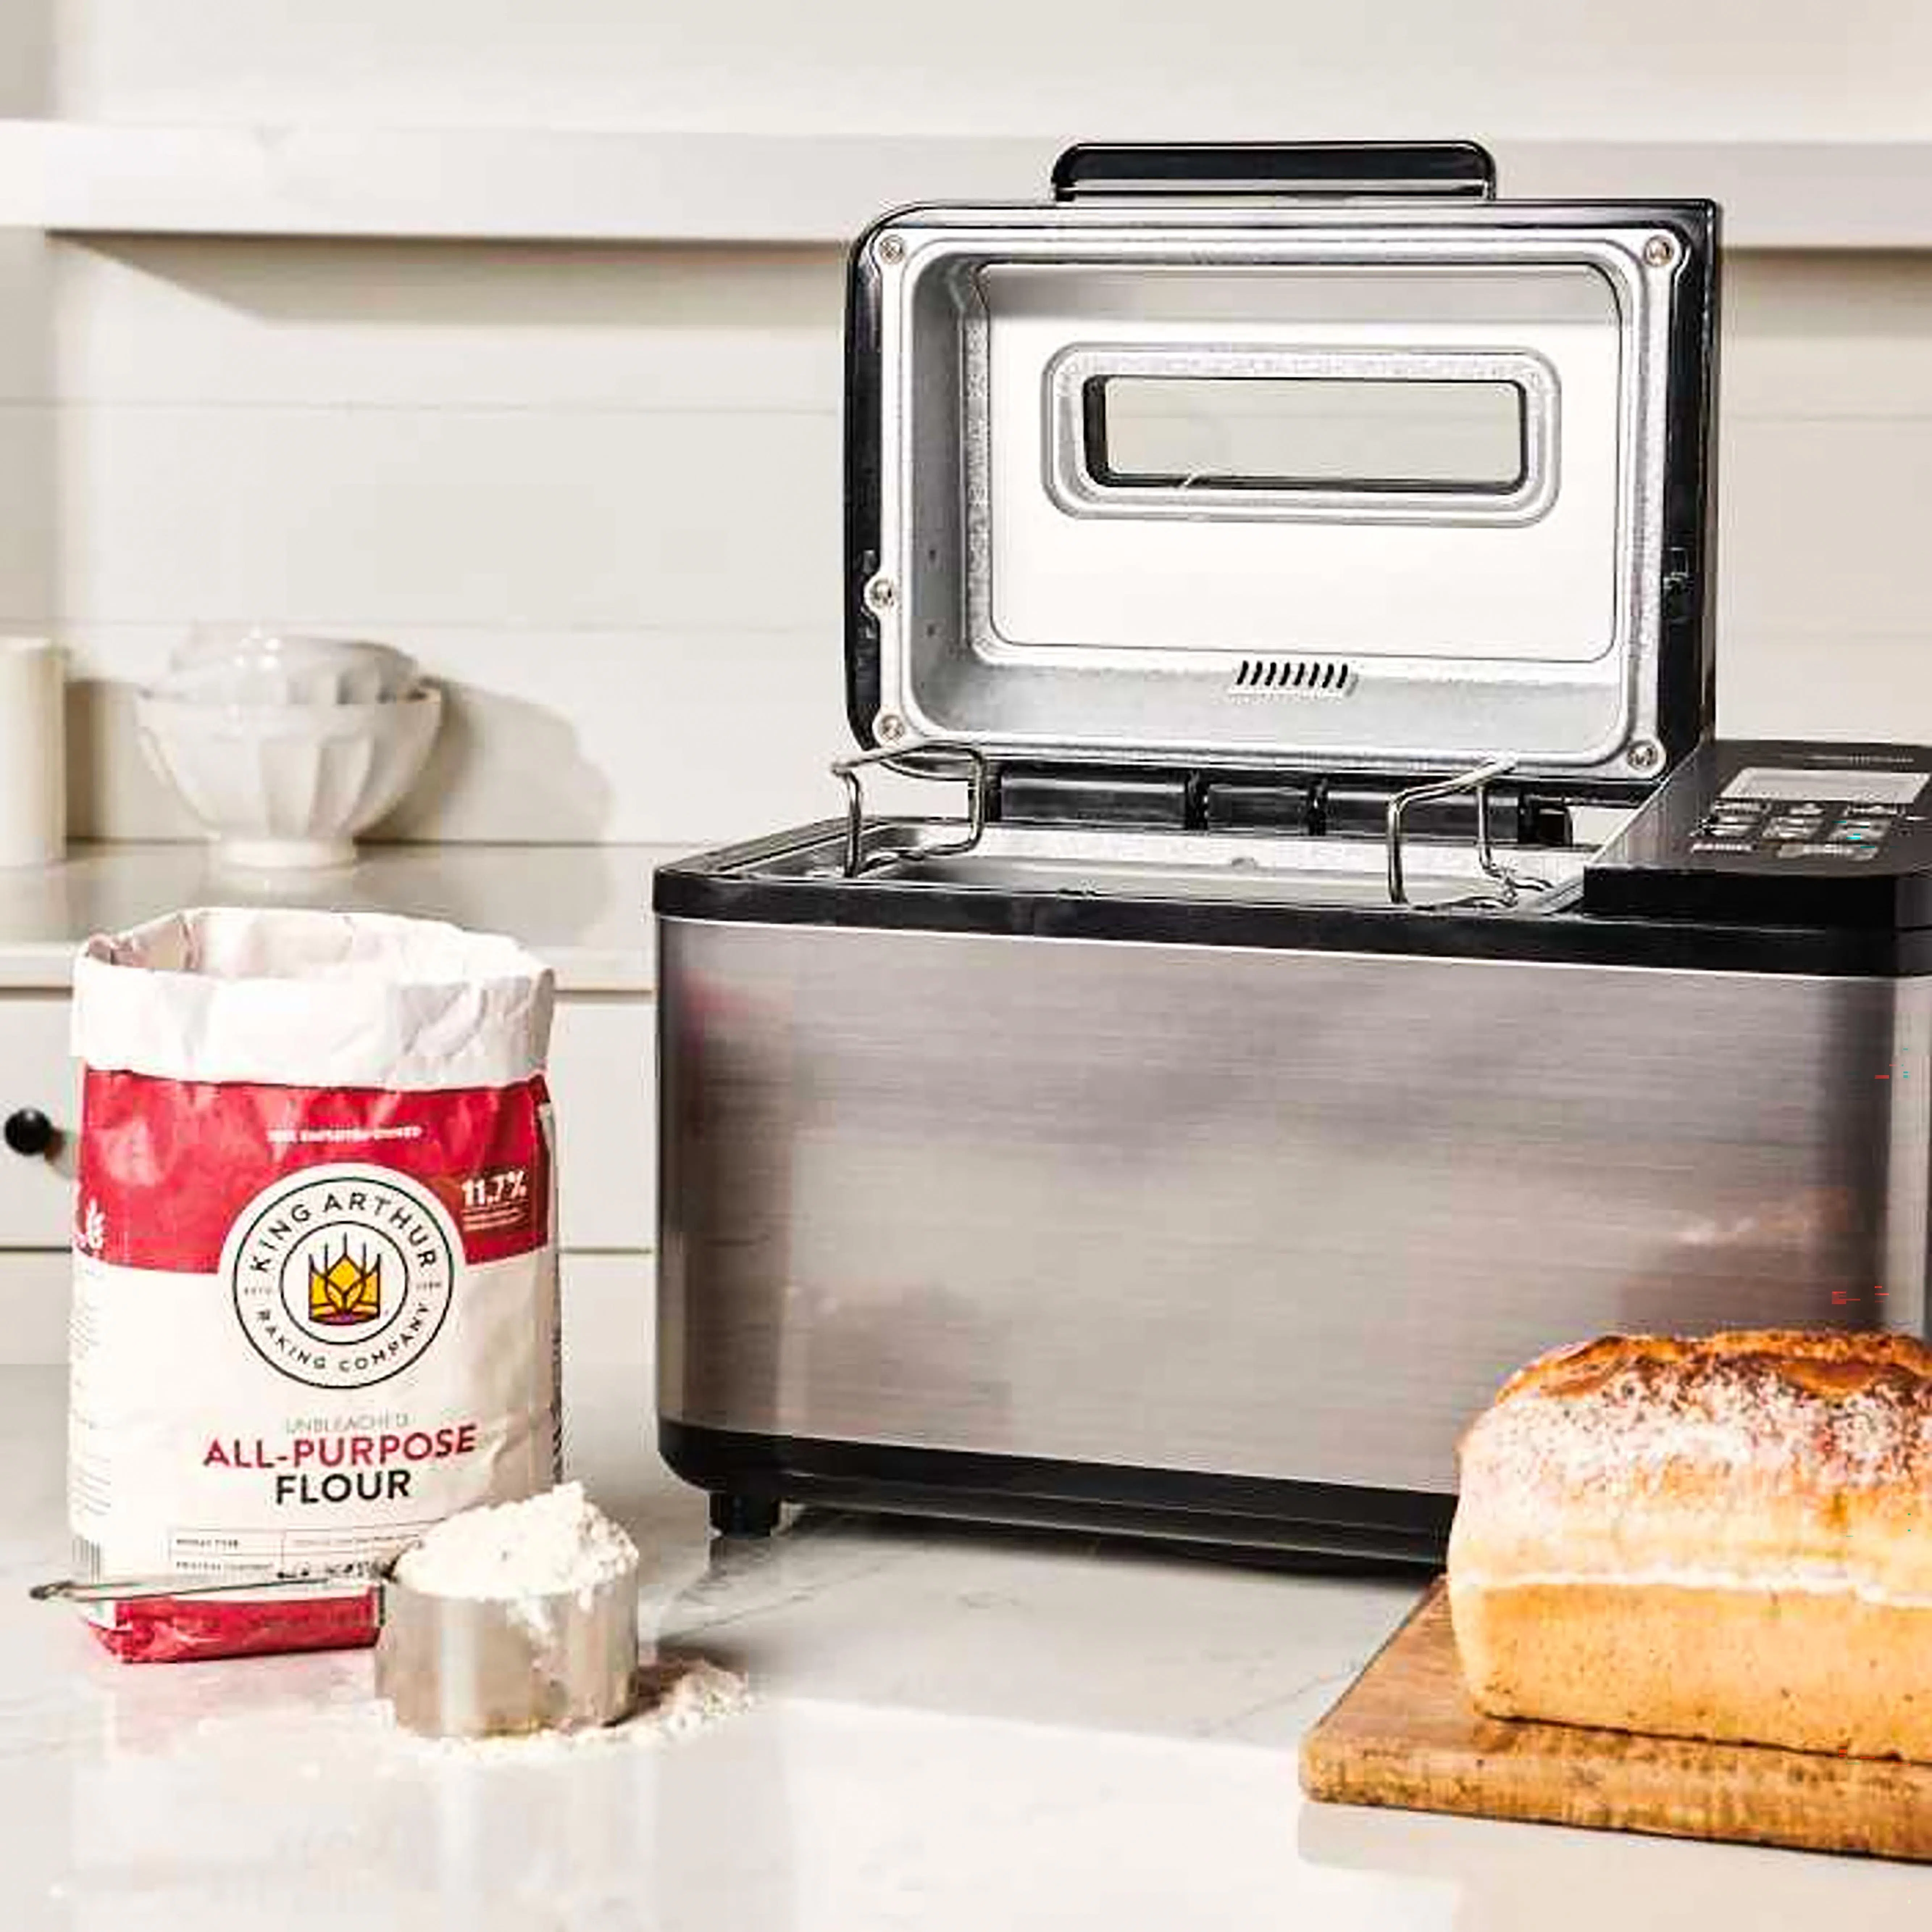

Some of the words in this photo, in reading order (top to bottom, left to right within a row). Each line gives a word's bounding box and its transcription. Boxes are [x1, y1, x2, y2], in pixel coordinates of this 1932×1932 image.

[461, 1170, 527, 1205] 11.7%
[251, 1203, 312, 1273] KING
[323, 1192, 436, 1268] ARTHUR
[339, 1302, 430, 1372] COMPANY
[286, 1411, 408, 1434] UNBLEACHD
[204, 1425, 477, 1468] ALL-PURPOSE
[276, 1469, 411, 1505] FLOUR
